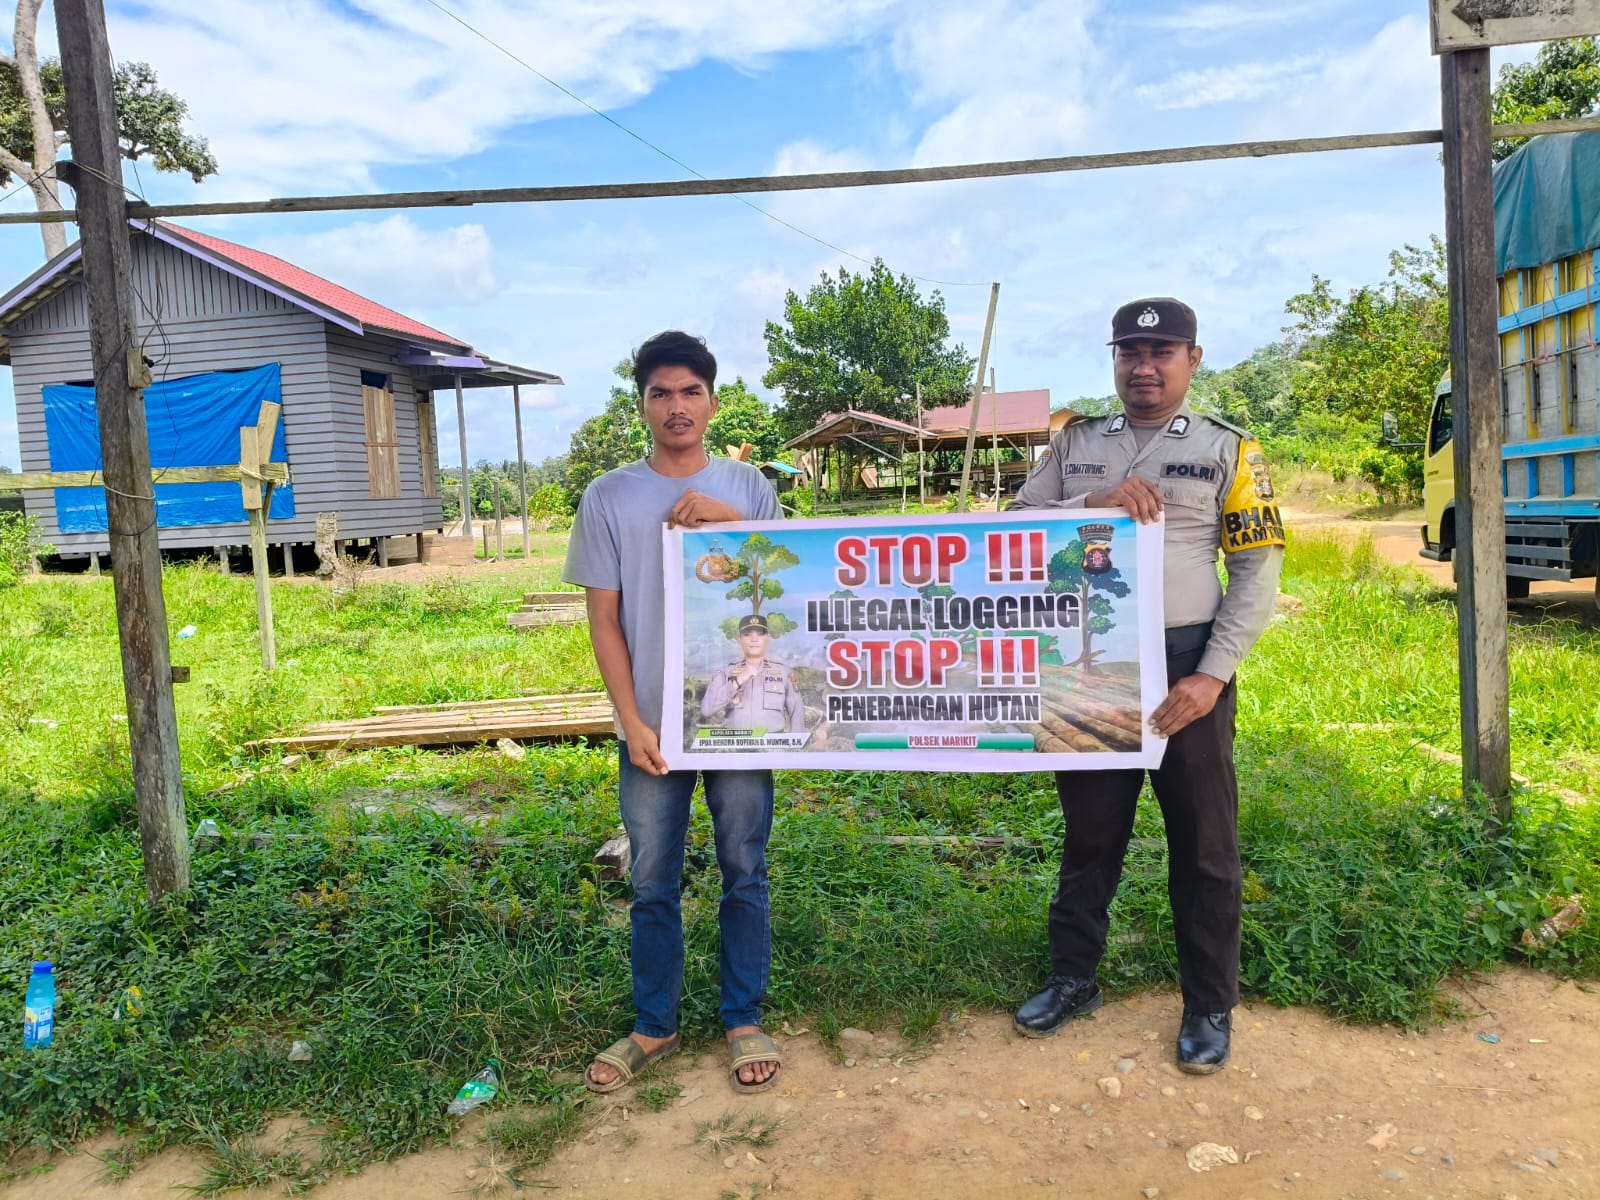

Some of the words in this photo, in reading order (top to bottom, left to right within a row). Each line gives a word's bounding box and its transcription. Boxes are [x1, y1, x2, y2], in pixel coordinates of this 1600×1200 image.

[1166, 464, 1216, 480] POLRI
[836, 534, 968, 587] STOP
[986, 531, 1046, 583] !!!
[807, 597, 926, 632] ILLEGAL
[933, 595, 1081, 630] LOGGING
[829, 639, 959, 687] STOP
[979, 638, 1038, 686] !!!
[828, 695, 963, 721] PENEBANGAN
[968, 695, 1040, 721] HUTAN
[909, 735, 939, 746] POLSEK
[942, 735, 977, 746] MARIKIT
